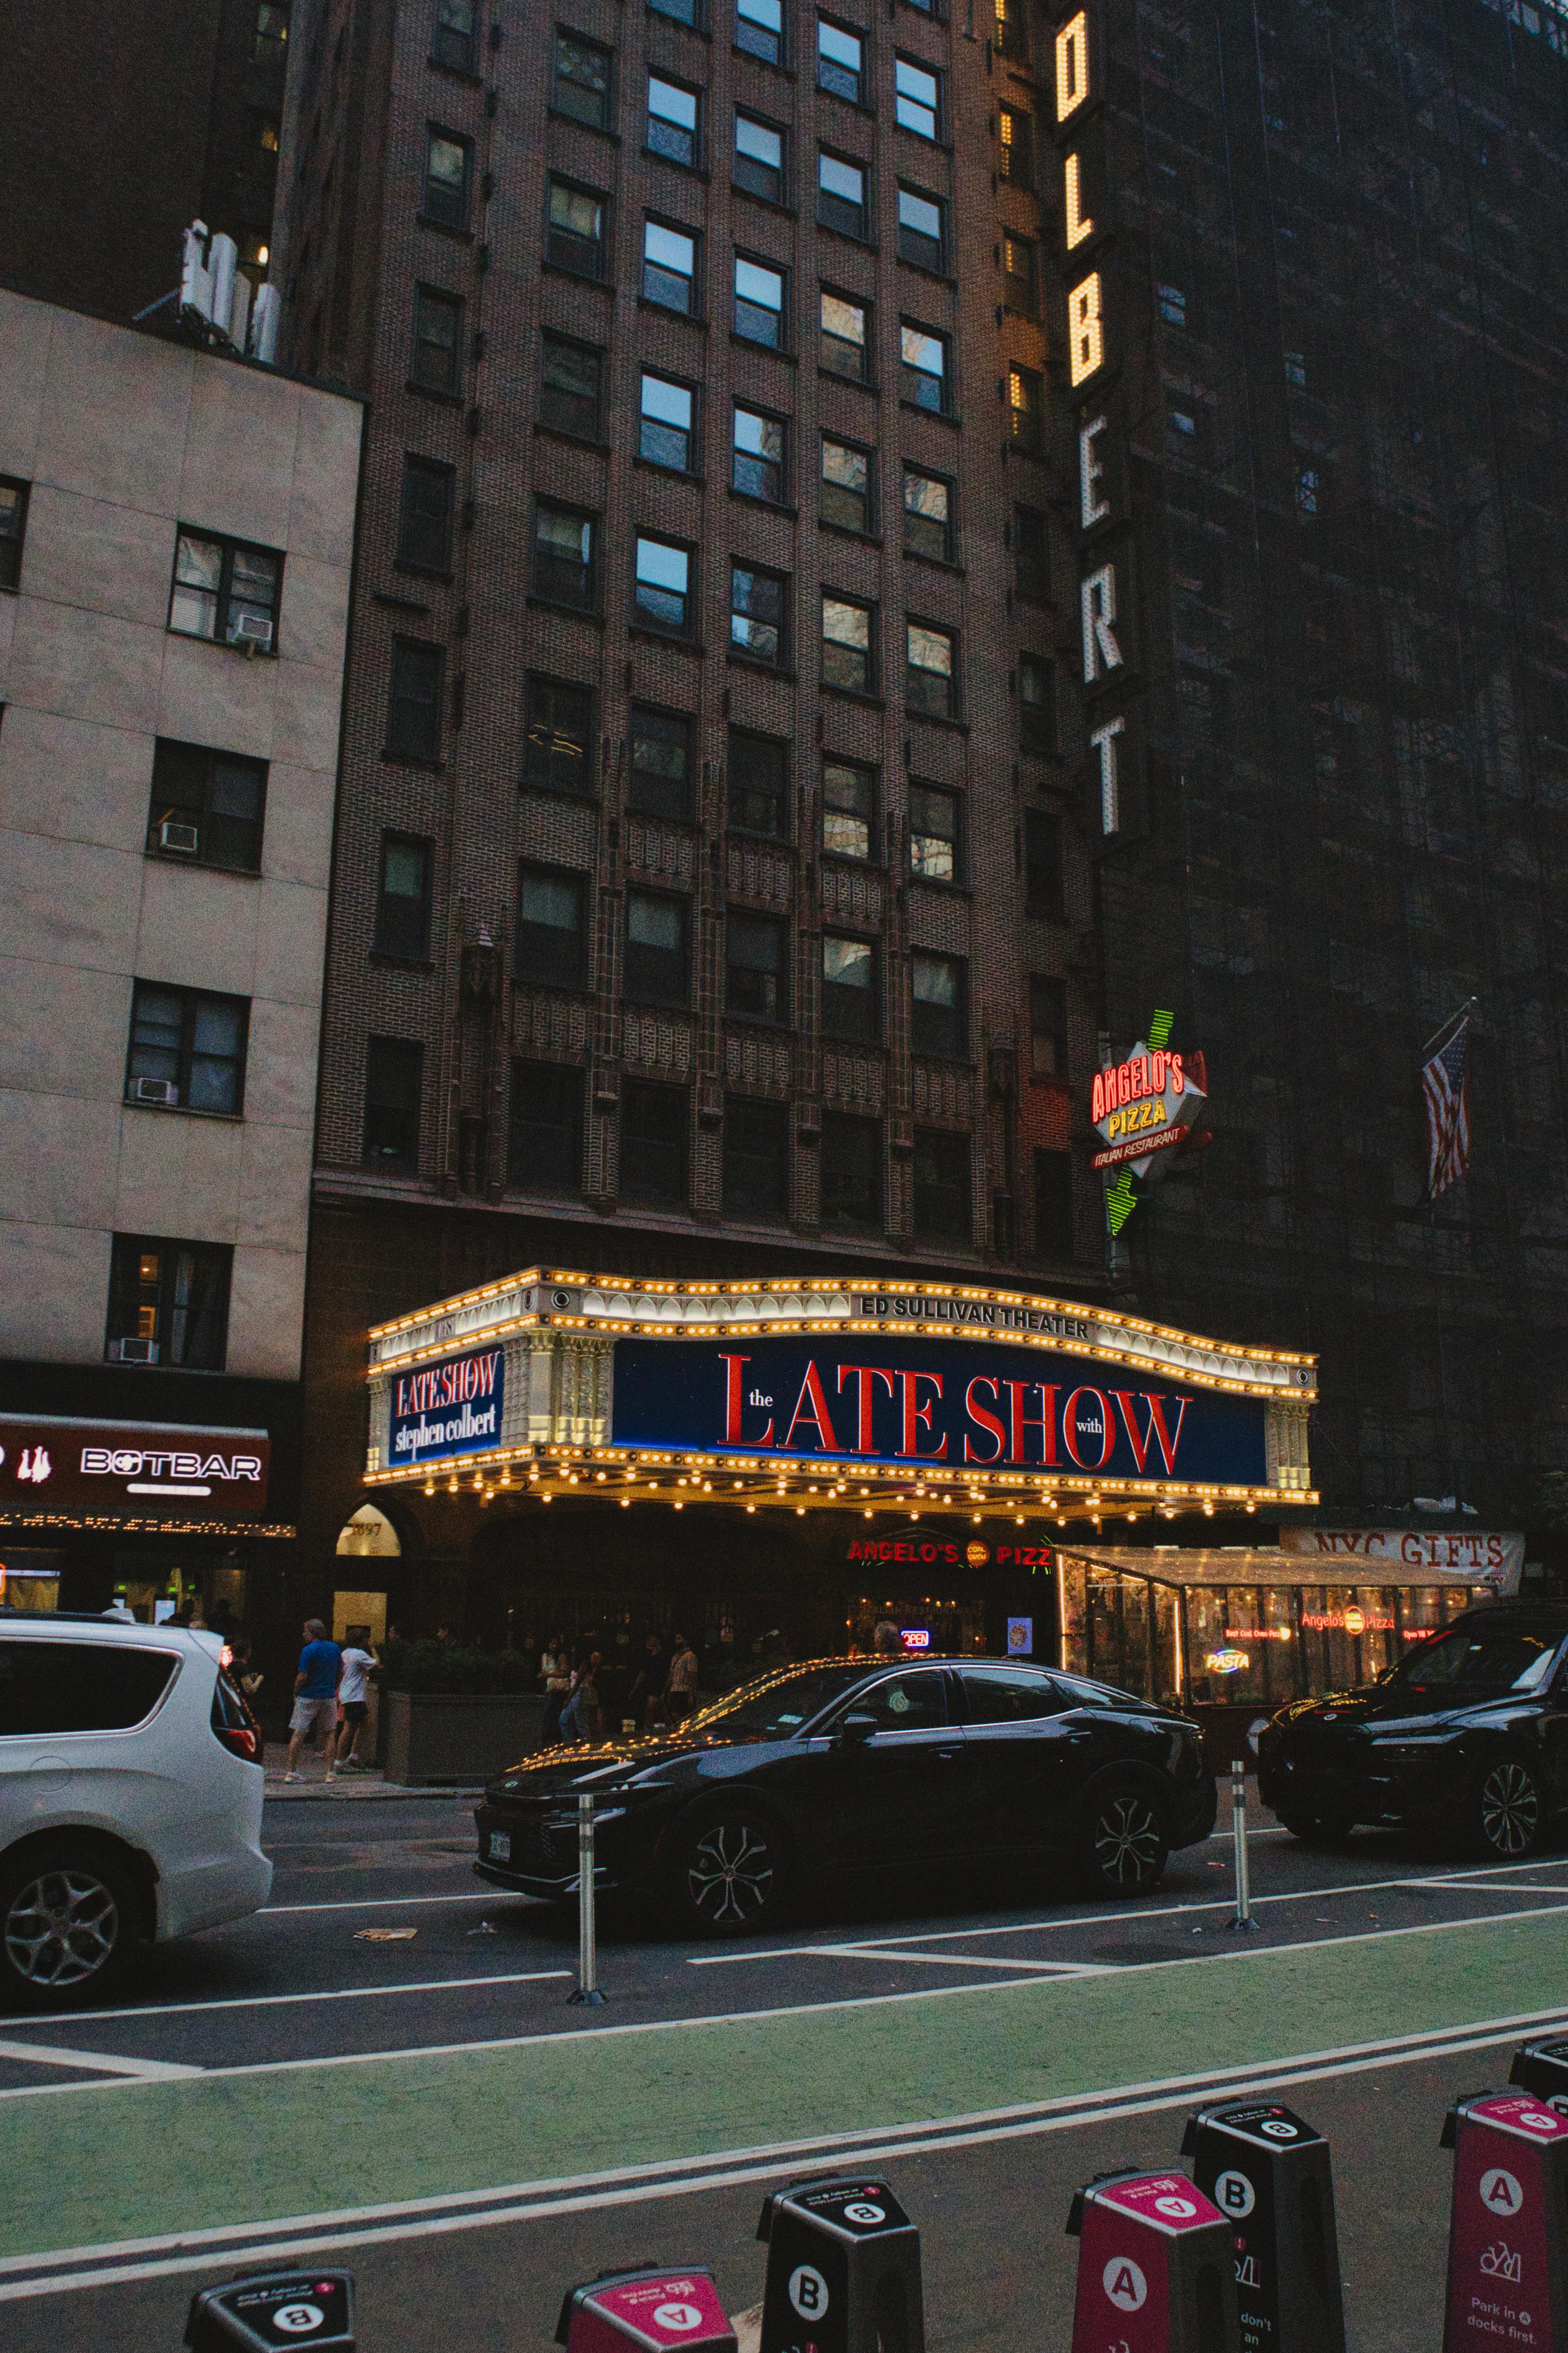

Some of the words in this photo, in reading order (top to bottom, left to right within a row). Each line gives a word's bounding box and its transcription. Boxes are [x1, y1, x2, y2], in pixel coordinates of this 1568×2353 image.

[1092, 1050, 1184, 1123] ANGELO'S
[1109, 1099, 1167, 1137] PIZZA
[1095, 1148, 1123, 1166] ITALIAN
[1124, 1128, 1180, 1156] RESTAURANT
[861, 1297, 889, 1316] ED
[893, 1299, 995, 1324] SULLIVAN
[999, 1308, 1089, 1339] THEATER
[396, 1368, 440, 1417] LATE
[441, 1351, 500, 1407] SHOW
[749, 1389, 773, 1407] the
[717, 1353, 947, 1459] LATE
[964, 1376, 1194, 1476] SHOW
[1076, 1417, 1102, 1434] with
[395, 1415, 445, 1461] stephen
[445, 1403, 496, 1441] colbert
[80, 1448, 261, 1481] BOTBAR
[847, 1541, 958, 1563] ANGELO'S
[1401, 1533, 1504, 1567] GIFTS
[1301, 1611, 1344, 1631] Angelo's
[1366, 1615, 1395, 1630] Pizza
[903, 1633, 926, 1644] OPEN
[1207, 1654, 1249, 1668] PASTA
[1225, 2178, 1245, 2208] B
[1488, 2177, 1513, 2207] A
[799, 2273, 819, 2310] B
[1112, 2266, 1137, 2302] A
[1241, 2312, 1272, 2332] don't
[1471, 2297, 1500, 2315] Park
[1504, 2306, 1516, 2320] in
[1467, 2315, 1505, 2335] docks
[1508, 2326, 1537, 2345] first.
